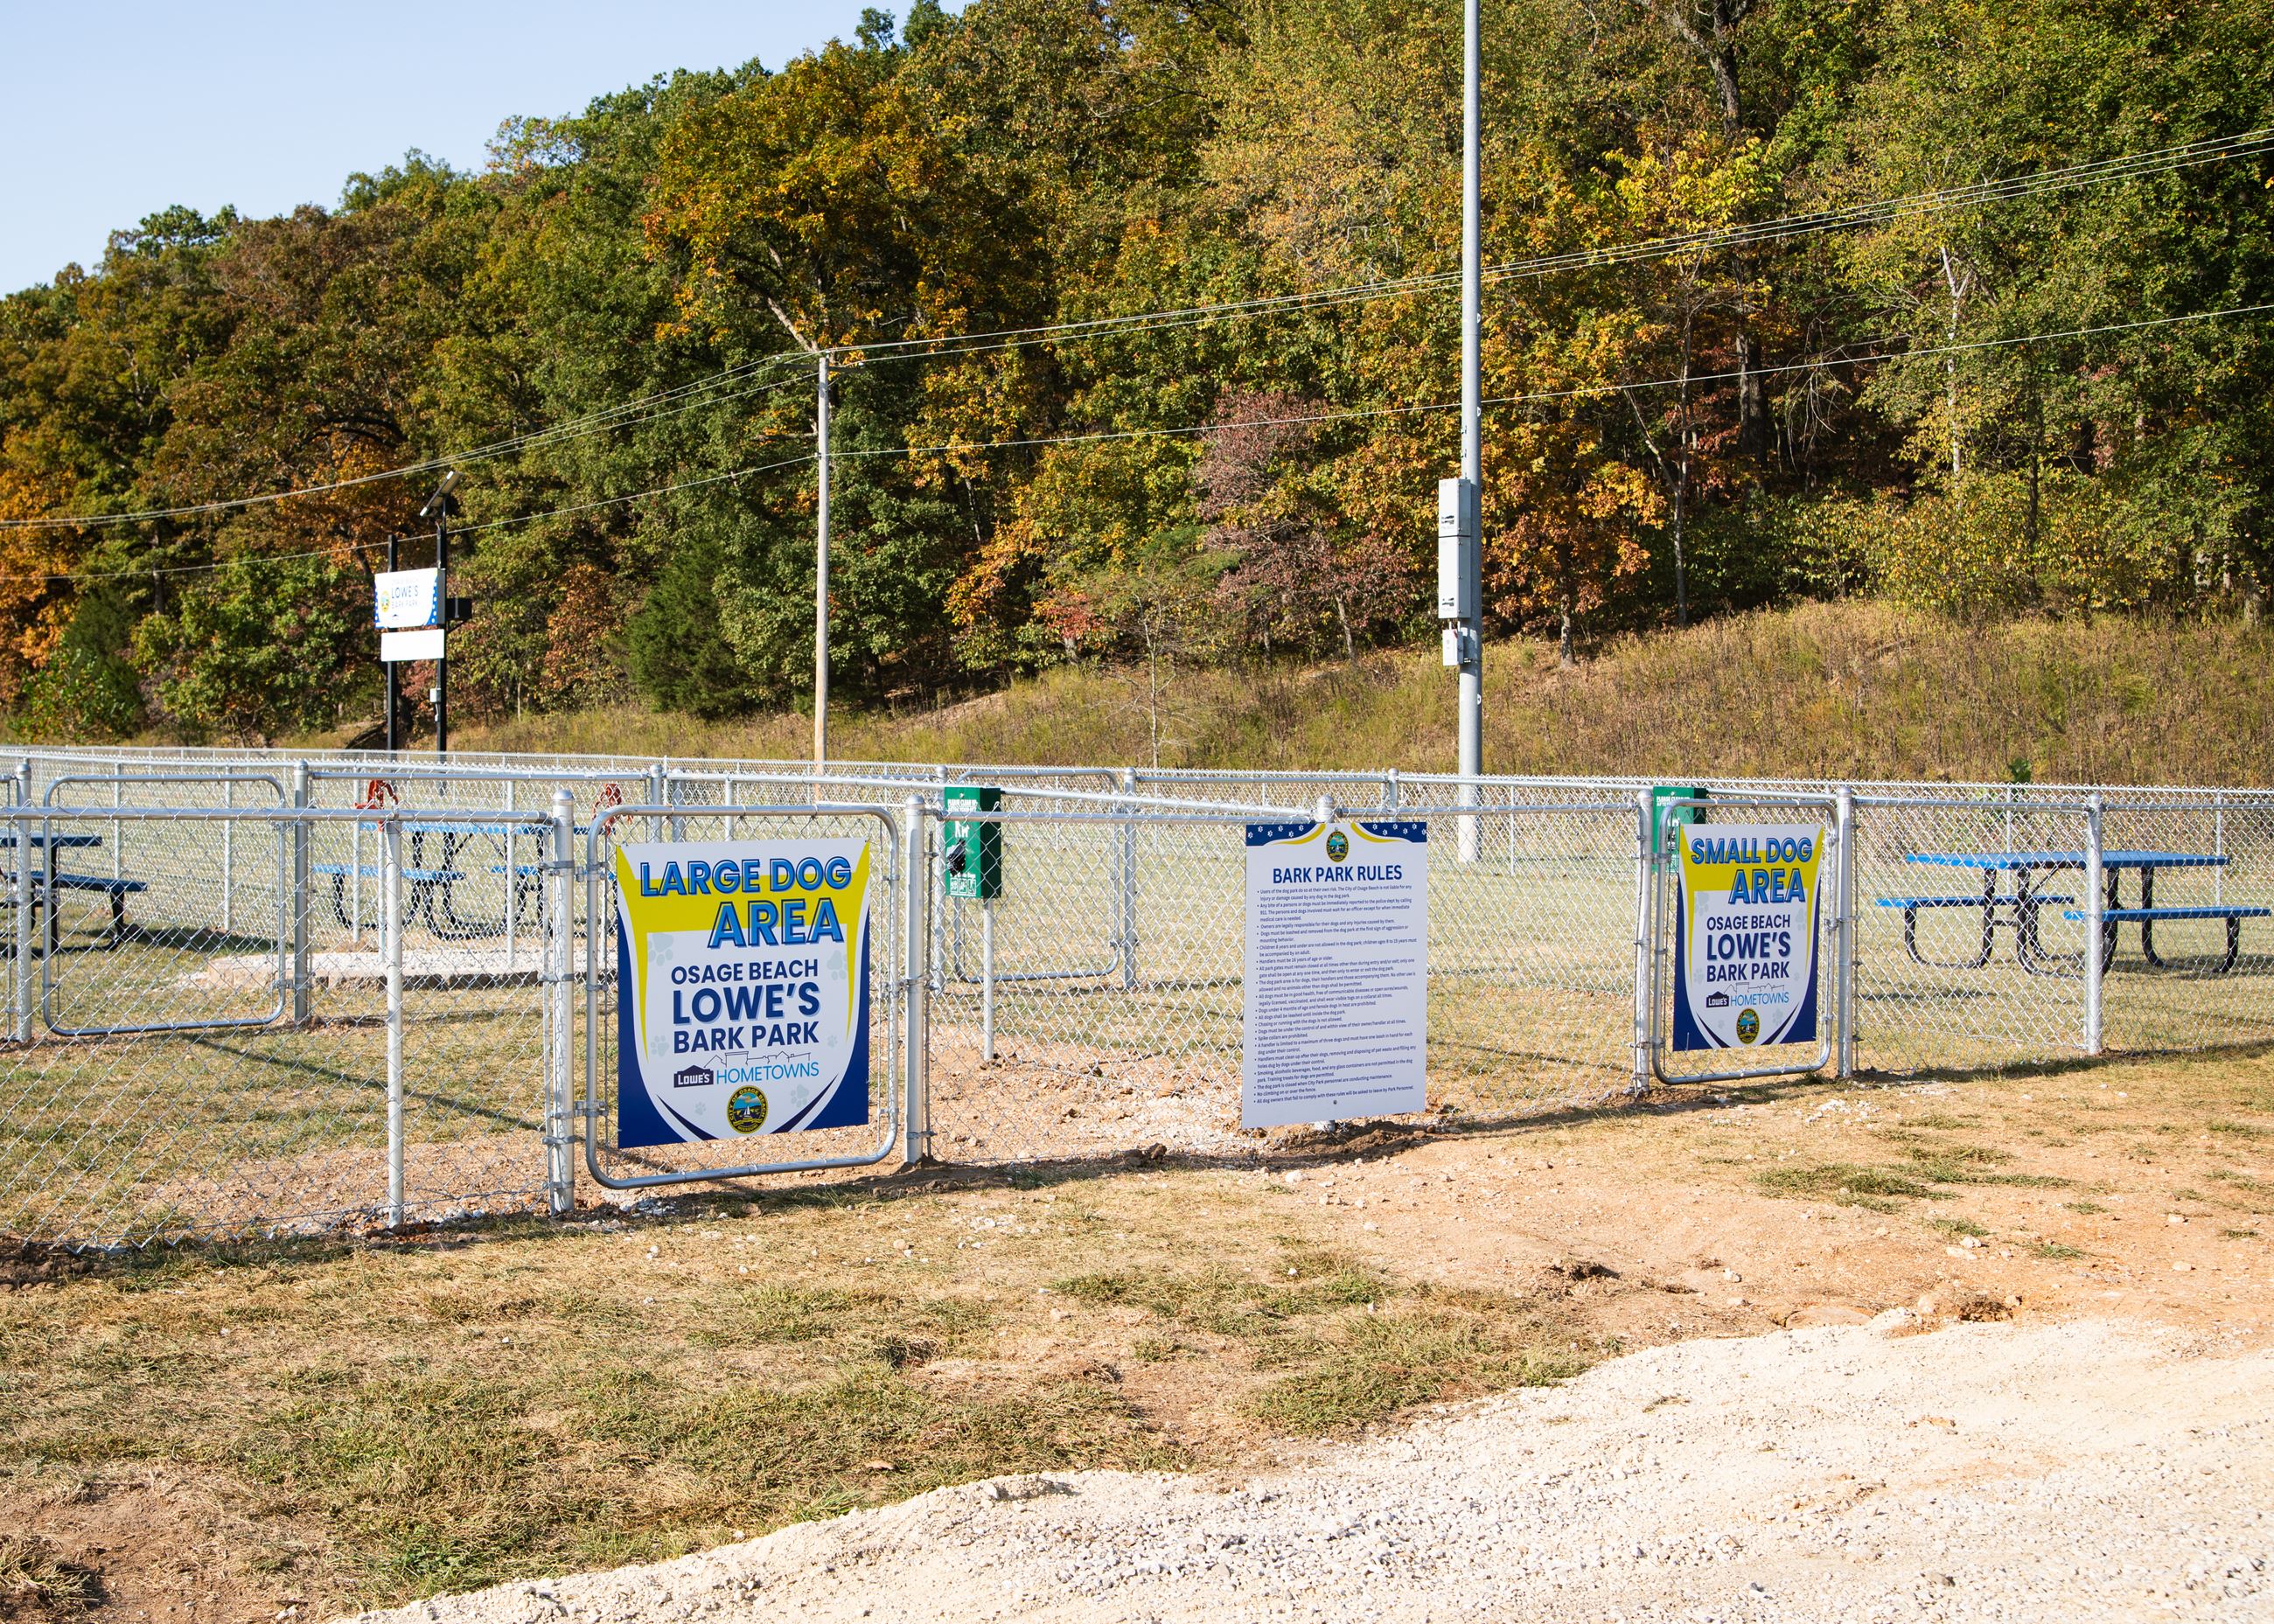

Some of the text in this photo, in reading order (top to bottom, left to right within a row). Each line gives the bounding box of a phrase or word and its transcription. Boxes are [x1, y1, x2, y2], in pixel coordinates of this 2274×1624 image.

[1691, 836, 1813, 865] SMALL DOG
[640, 855, 852, 897] LARGE DOG
[1273, 864, 1402, 884] BARK PARK RULES
[1728, 868, 1806, 905] AREA
[707, 897, 844, 949] AREA
[1706, 913, 1791, 931] OSAGE BEACH
[1707, 931, 1791, 961] LOWE'S
[671, 959, 818, 985] OSAGE BEACH
[1706, 961, 1789, 983] BARK PARK
[673, 982, 820, 1025] LOWE'S
[1730, 991, 1789, 1007] HOMETOWNS
[673, 1021, 820, 1054] BARK PARK
[716, 1062, 819, 1085] HOMETOWNS
